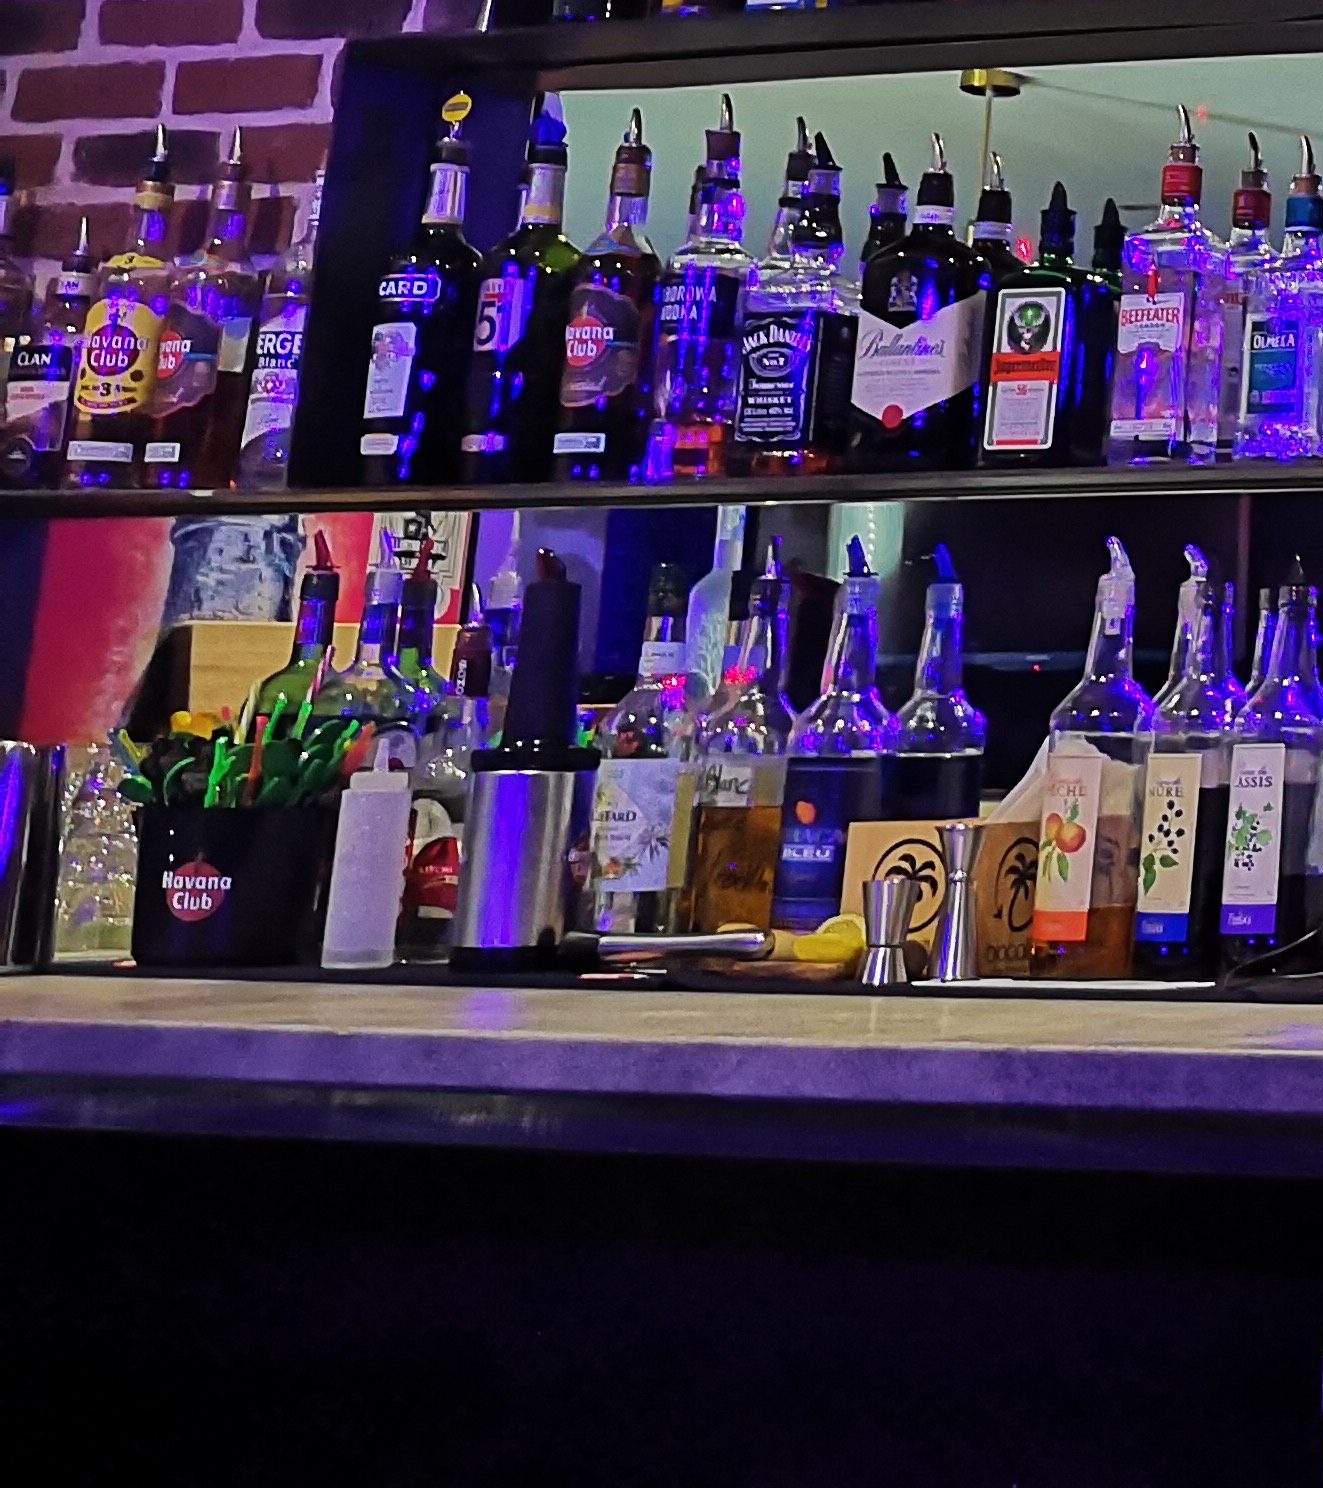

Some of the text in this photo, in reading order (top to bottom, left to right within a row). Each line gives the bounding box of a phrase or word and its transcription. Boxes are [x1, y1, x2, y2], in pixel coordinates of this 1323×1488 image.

[1121, 307, 1180, 327] BEEFEATER
[91, 351, 130, 368] Club
[162, 870, 232, 890] Havana
[172, 891, 213, 910] Club
